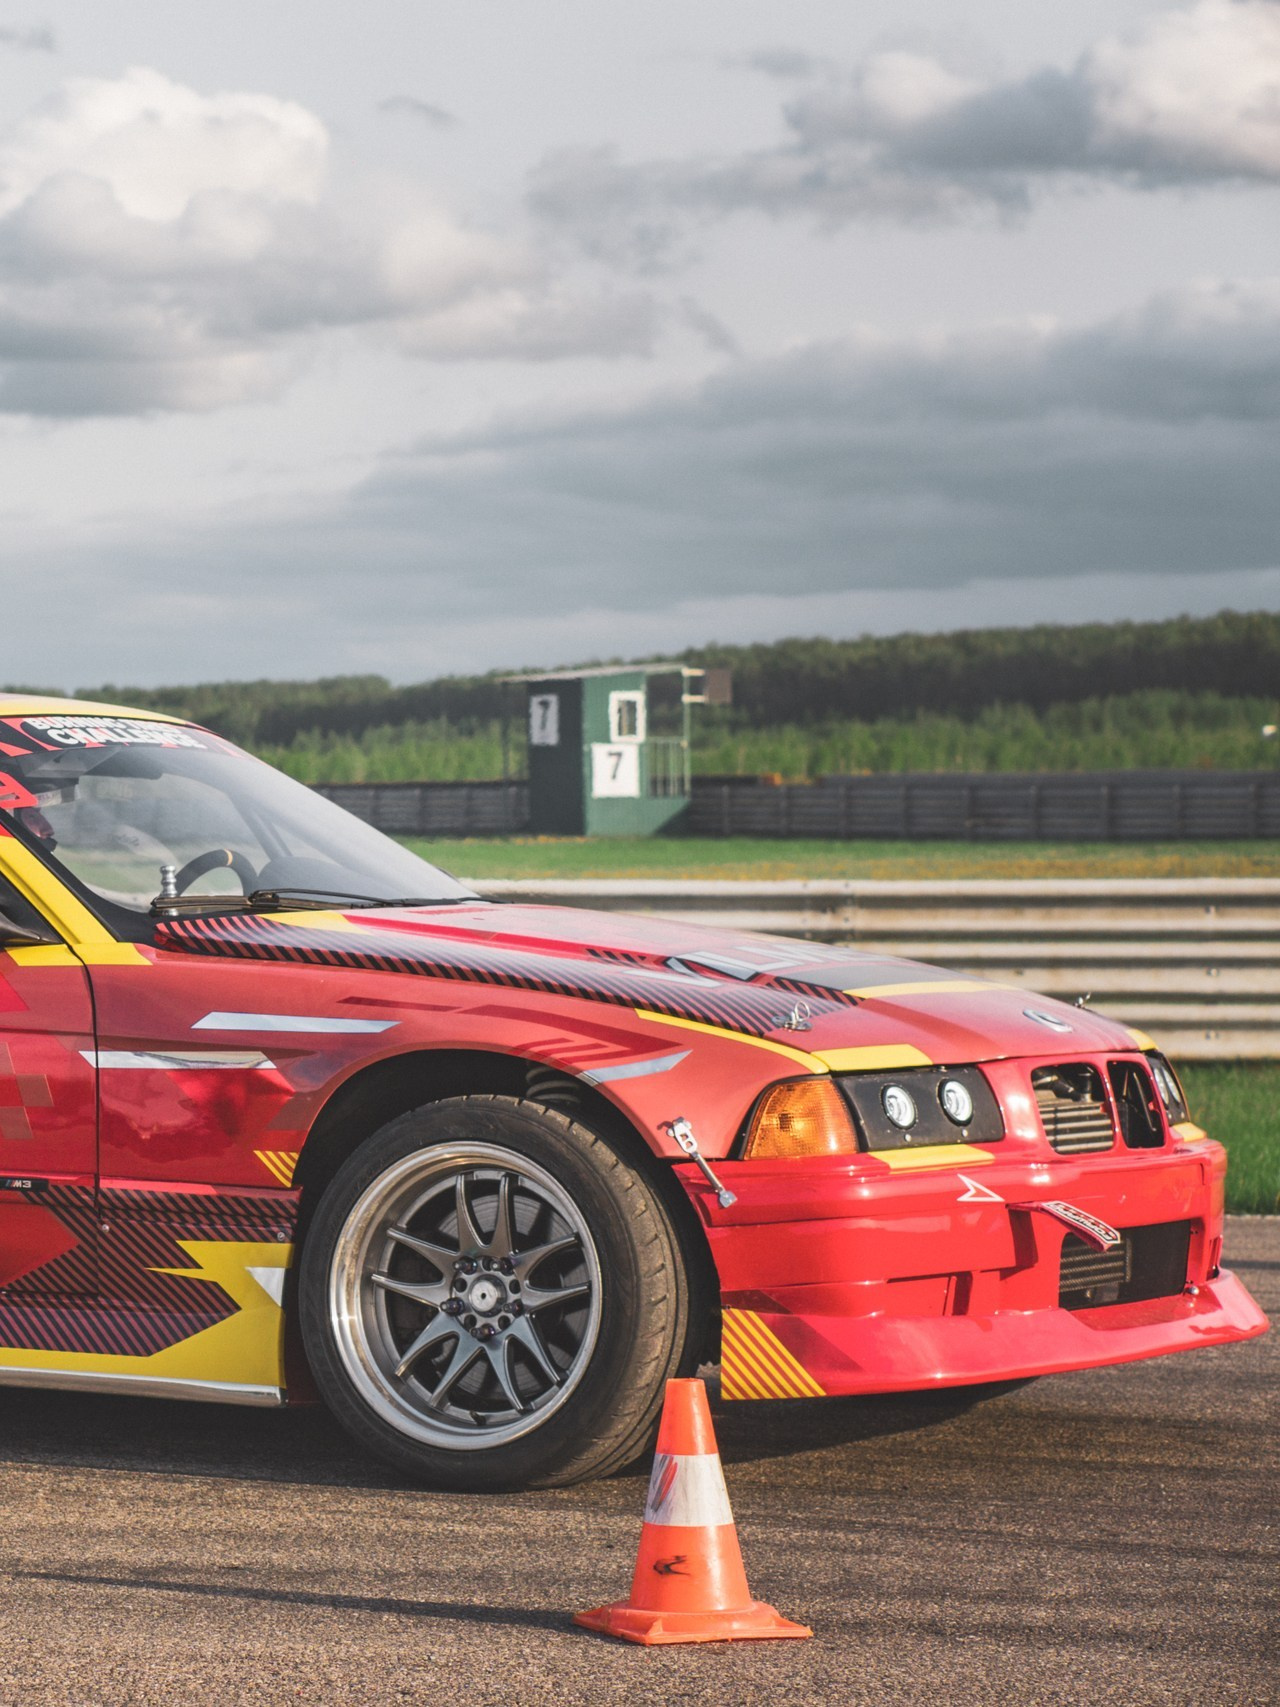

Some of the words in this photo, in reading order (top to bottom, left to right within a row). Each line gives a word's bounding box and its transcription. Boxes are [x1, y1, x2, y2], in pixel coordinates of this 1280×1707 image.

[538, 700, 550, 730] 7
[47, 727, 208, 749] CHALLENGE
[608, 751, 623, 780] 7
[10, 1179, 32, 1188] M3
